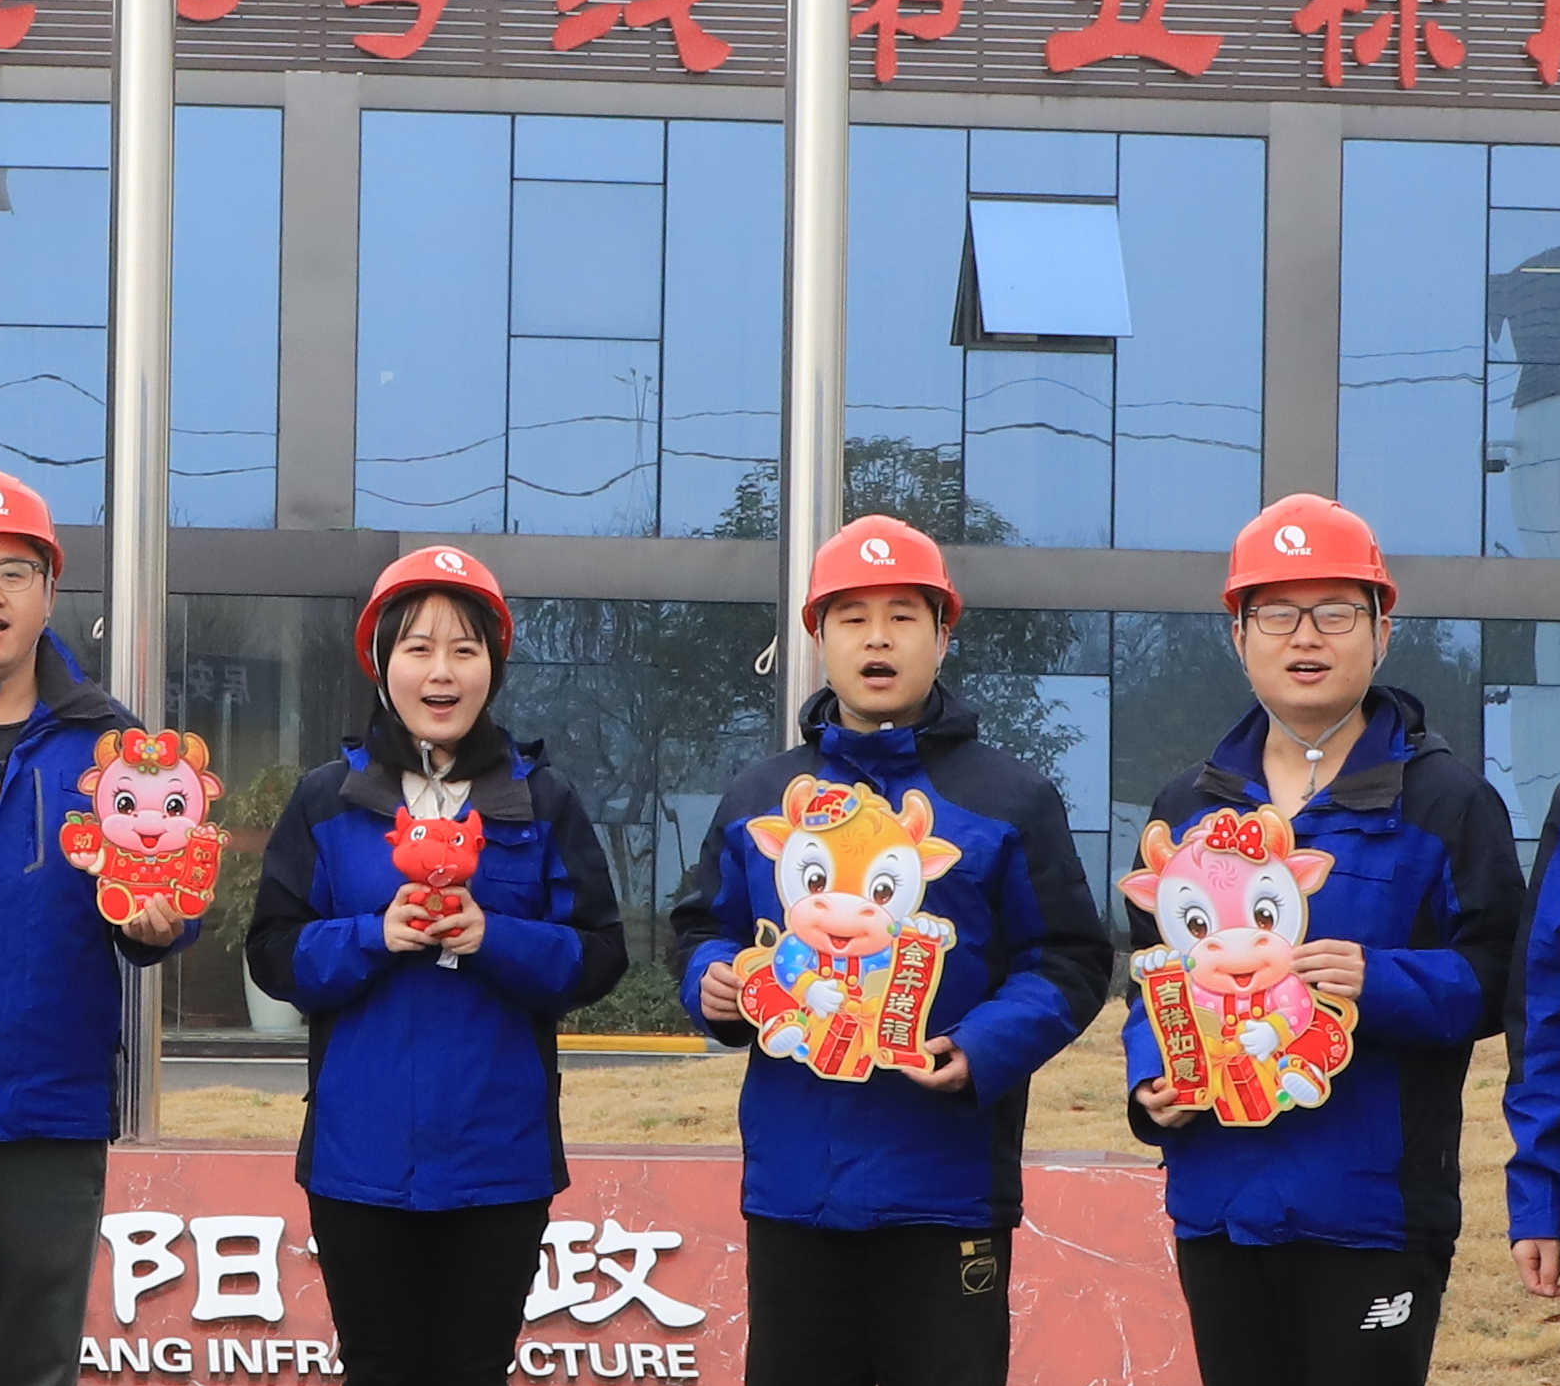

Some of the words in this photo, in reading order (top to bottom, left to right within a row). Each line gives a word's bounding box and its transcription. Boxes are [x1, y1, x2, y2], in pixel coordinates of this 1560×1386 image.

[1286, 547, 1313, 556] HYSZ
[880, 941, 932, 1046] 金牛送福
[1155, 980, 1201, 1083] 吉祥如意
[1360, 1291, 1413, 1329] NB
[207, 1338, 700, 1379] INFRCTURE
